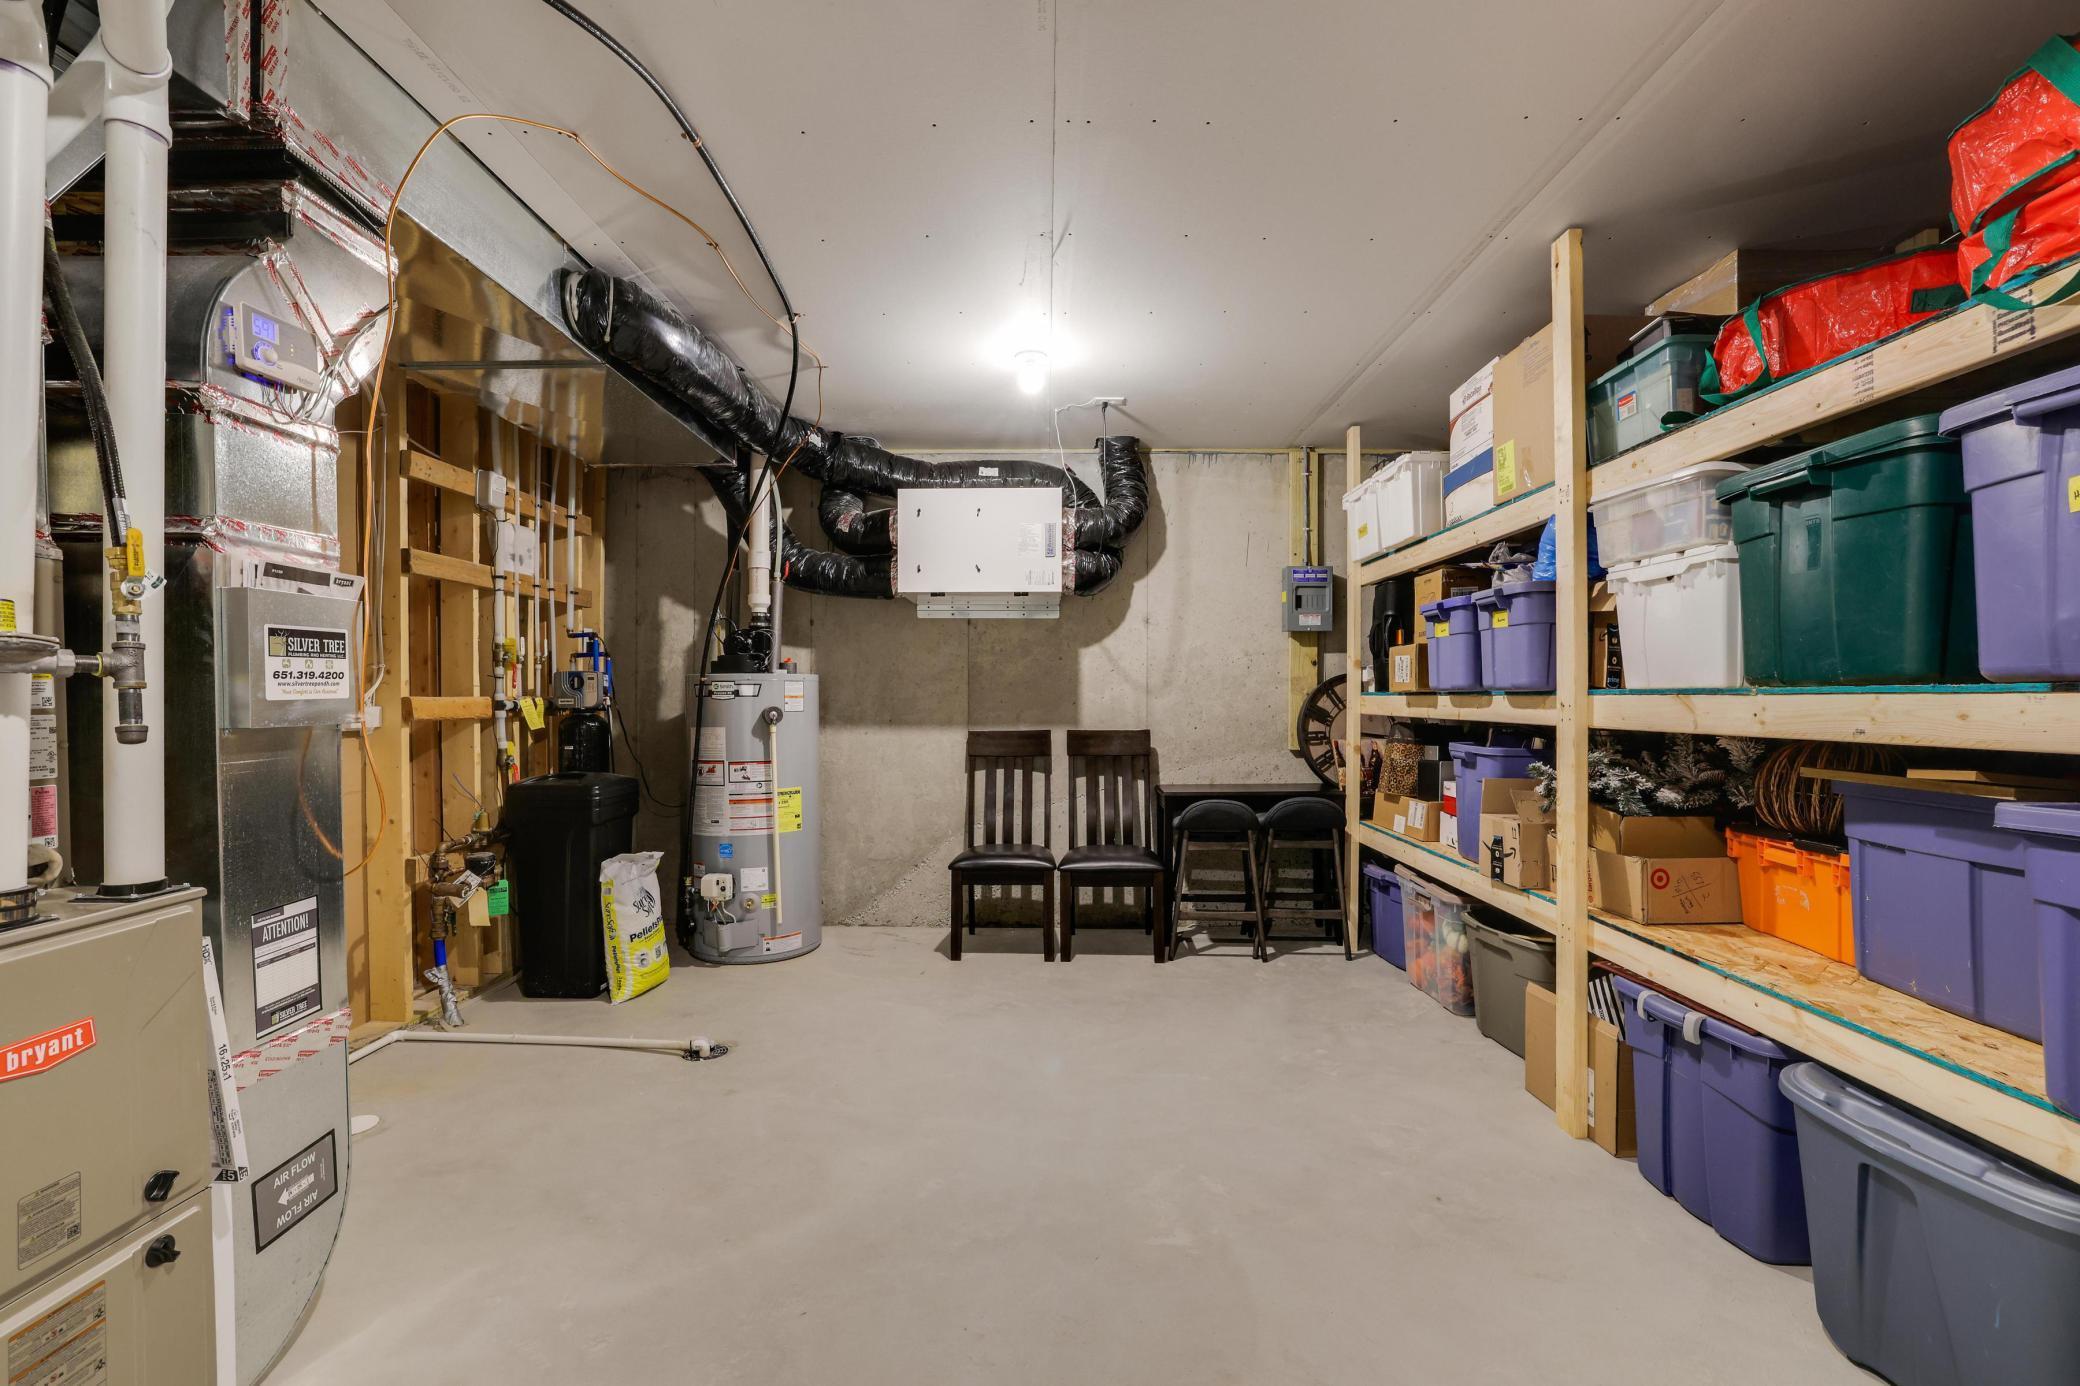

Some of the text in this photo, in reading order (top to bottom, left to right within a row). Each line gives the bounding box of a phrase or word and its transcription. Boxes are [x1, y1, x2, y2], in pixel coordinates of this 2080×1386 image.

[288, 637, 345, 653] SILVER TREE
[273, 670, 345, 680] 651.319.4200
[263, 914, 308, 942] ATTENTION!
[202, 944, 212, 965] HDX
[6, 1027, 84, 1073] bryant
[273, 1151, 316, 1190] AIR FLOW
[276, 1189, 318, 1229] AIR FLOW
